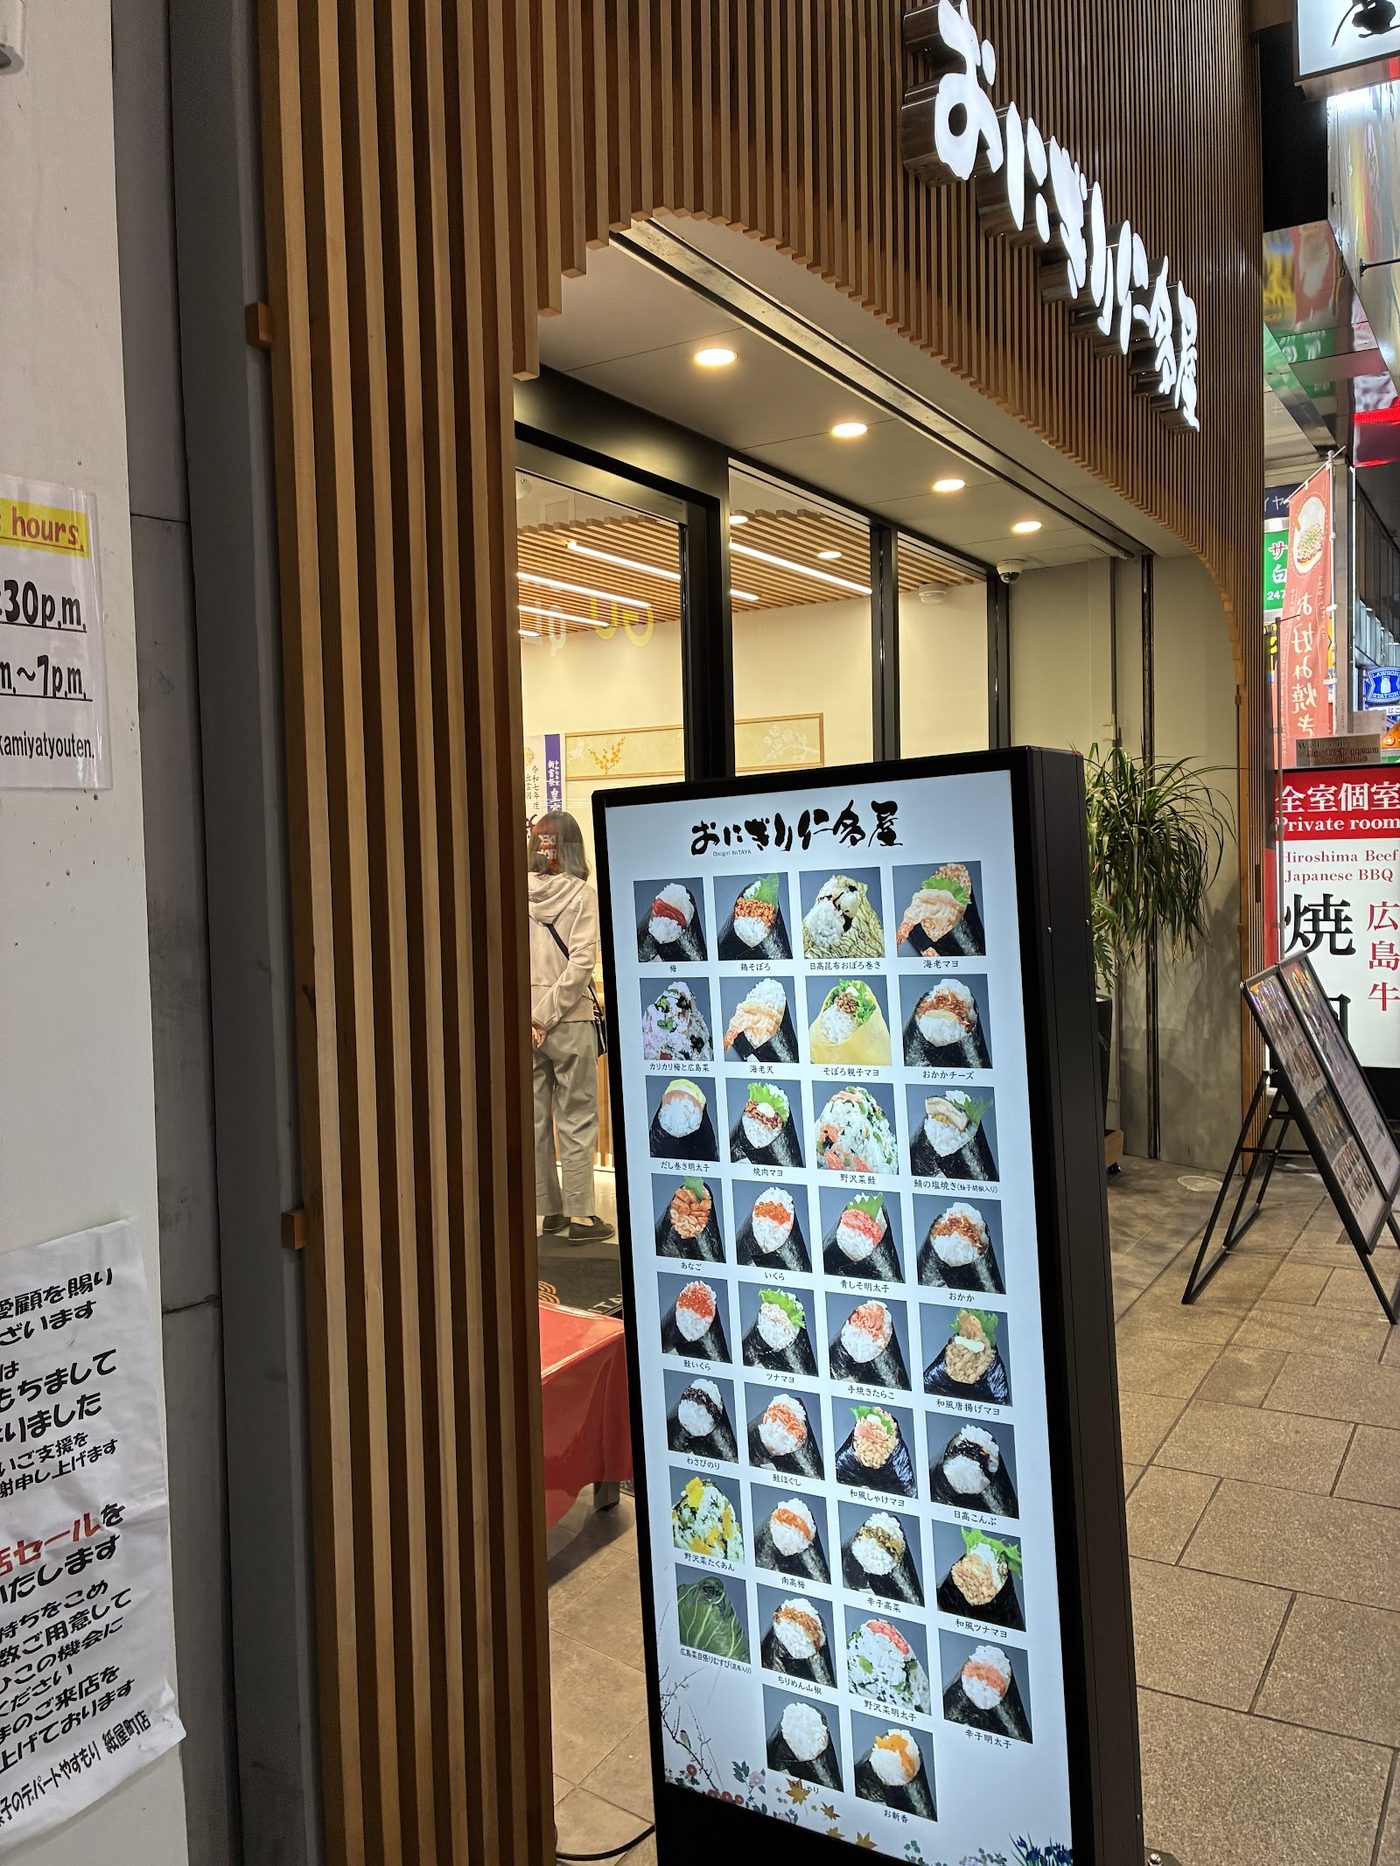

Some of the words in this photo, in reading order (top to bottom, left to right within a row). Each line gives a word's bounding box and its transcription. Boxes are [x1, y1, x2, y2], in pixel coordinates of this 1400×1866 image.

[1275, 781, 1400, 813] 全室個室
[1275, 816, 1345, 831] Private
[1365, 849, 1399, 862] Beef
[1285, 869, 1353, 884] Japanese
[1359, 868, 1393, 882] BBQ
[1367, 901, 1400, 1012] 広島牛
[923, 959, 959, 969] 海老マヨ
[922, 1070, 975, 1080] おかかチーズ
[681, 1262, 702, 1271] あなご
[764, 1272, 785, 1281] いくら
[949, 1293, 975, 1303] おかか
[765, 1373, 795, 1384] ツナマヨ
[0, 1392, 102, 1443] りました
[955, 1618, 1008, 1639] 和風ツナマヨ
[0, 1741, 101, 1827] 子のデパートやすもり
[102, 1710, 151, 1754] 紙屋町店
